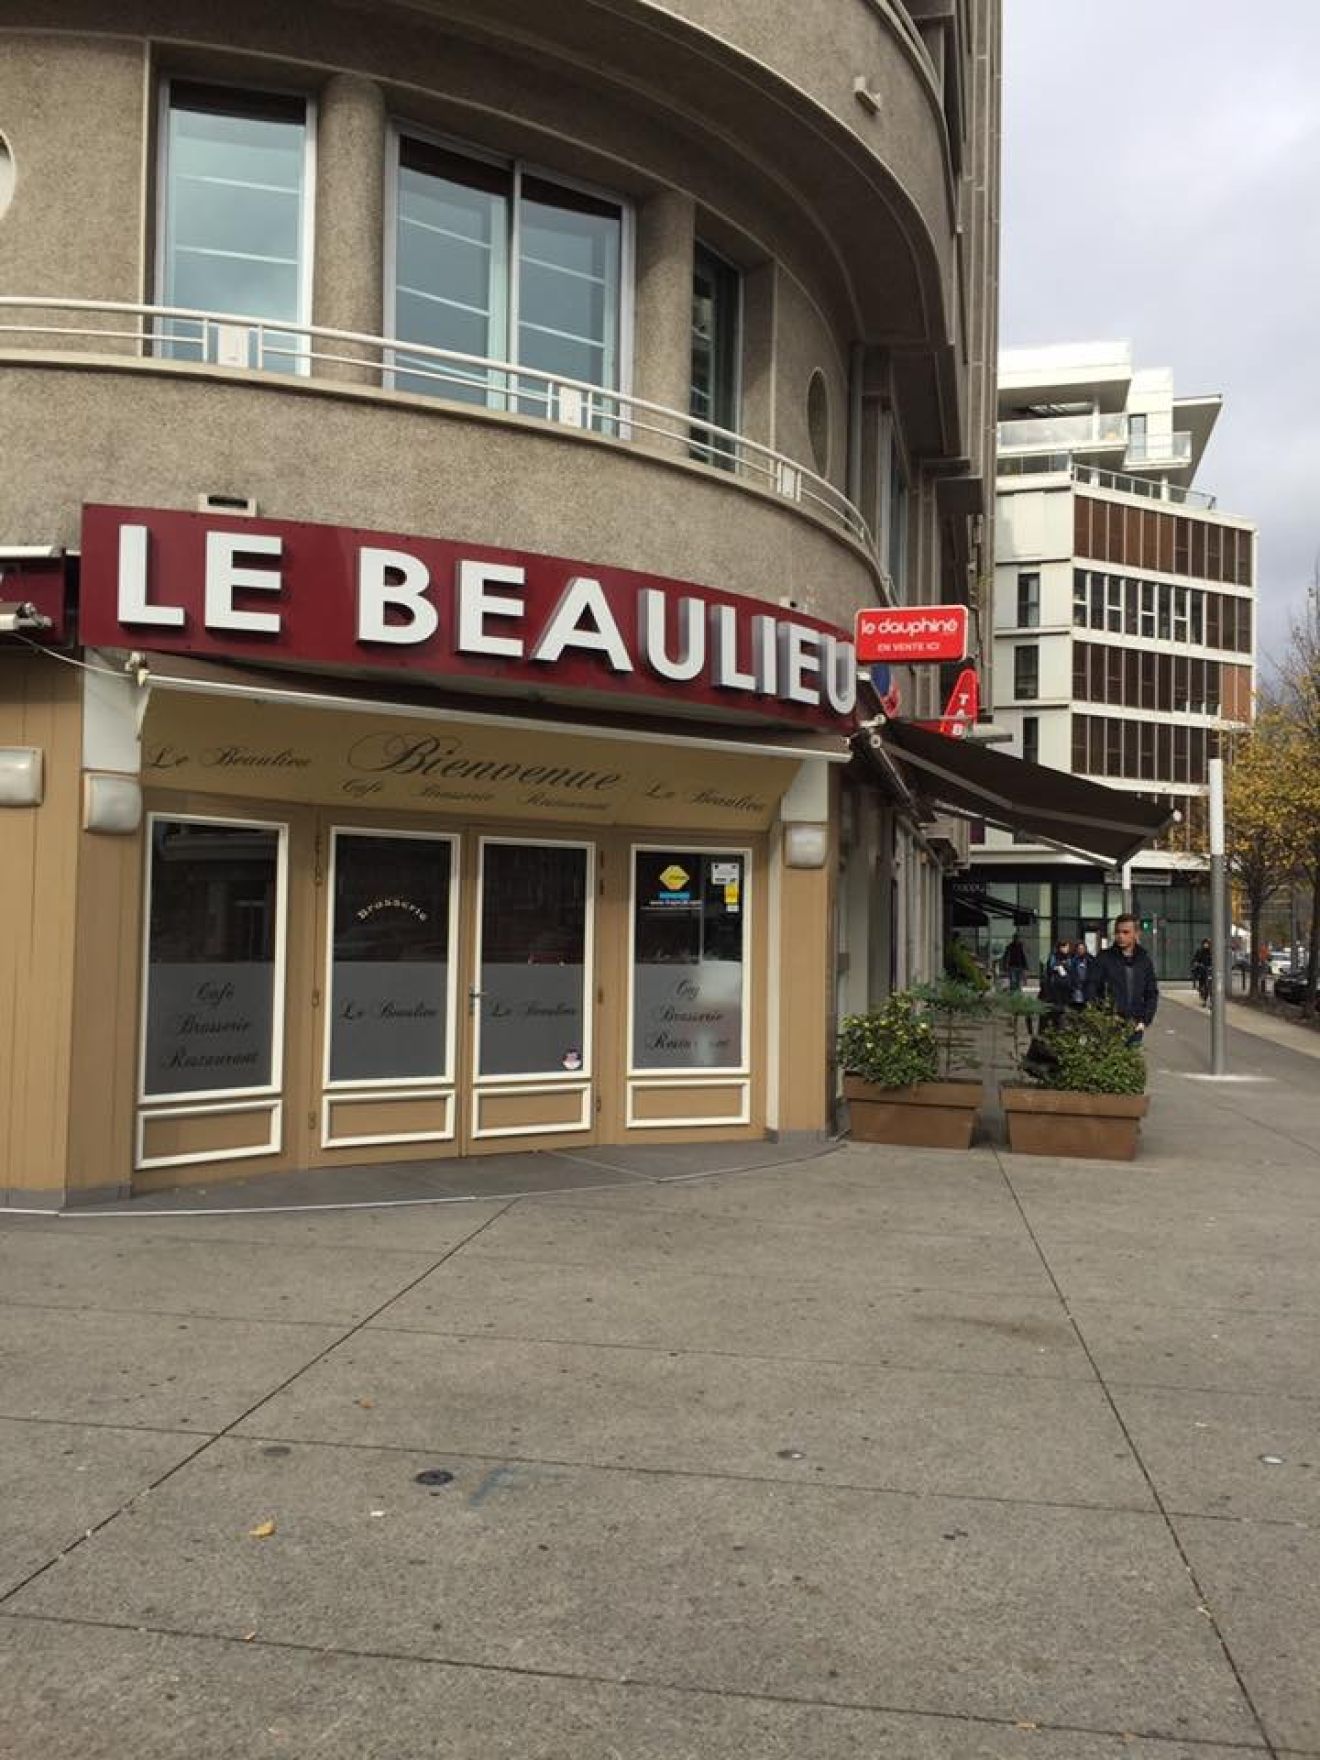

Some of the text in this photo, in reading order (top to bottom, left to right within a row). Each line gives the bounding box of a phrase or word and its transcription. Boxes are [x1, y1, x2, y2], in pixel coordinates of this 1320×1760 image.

[117, 524, 857, 715] LE BEAULIEU
[861, 619, 875, 635] le
[893, 641, 925, 652] VENTE
[148, 745, 312, 769] Le Beaulieu
[348, 732, 621, 792] Bienvenue
[341, 1001, 365, 1020] Le
[176, 1013, 251, 1035] Brasserie
[160, 1046, 260, 1070] Restaurant
